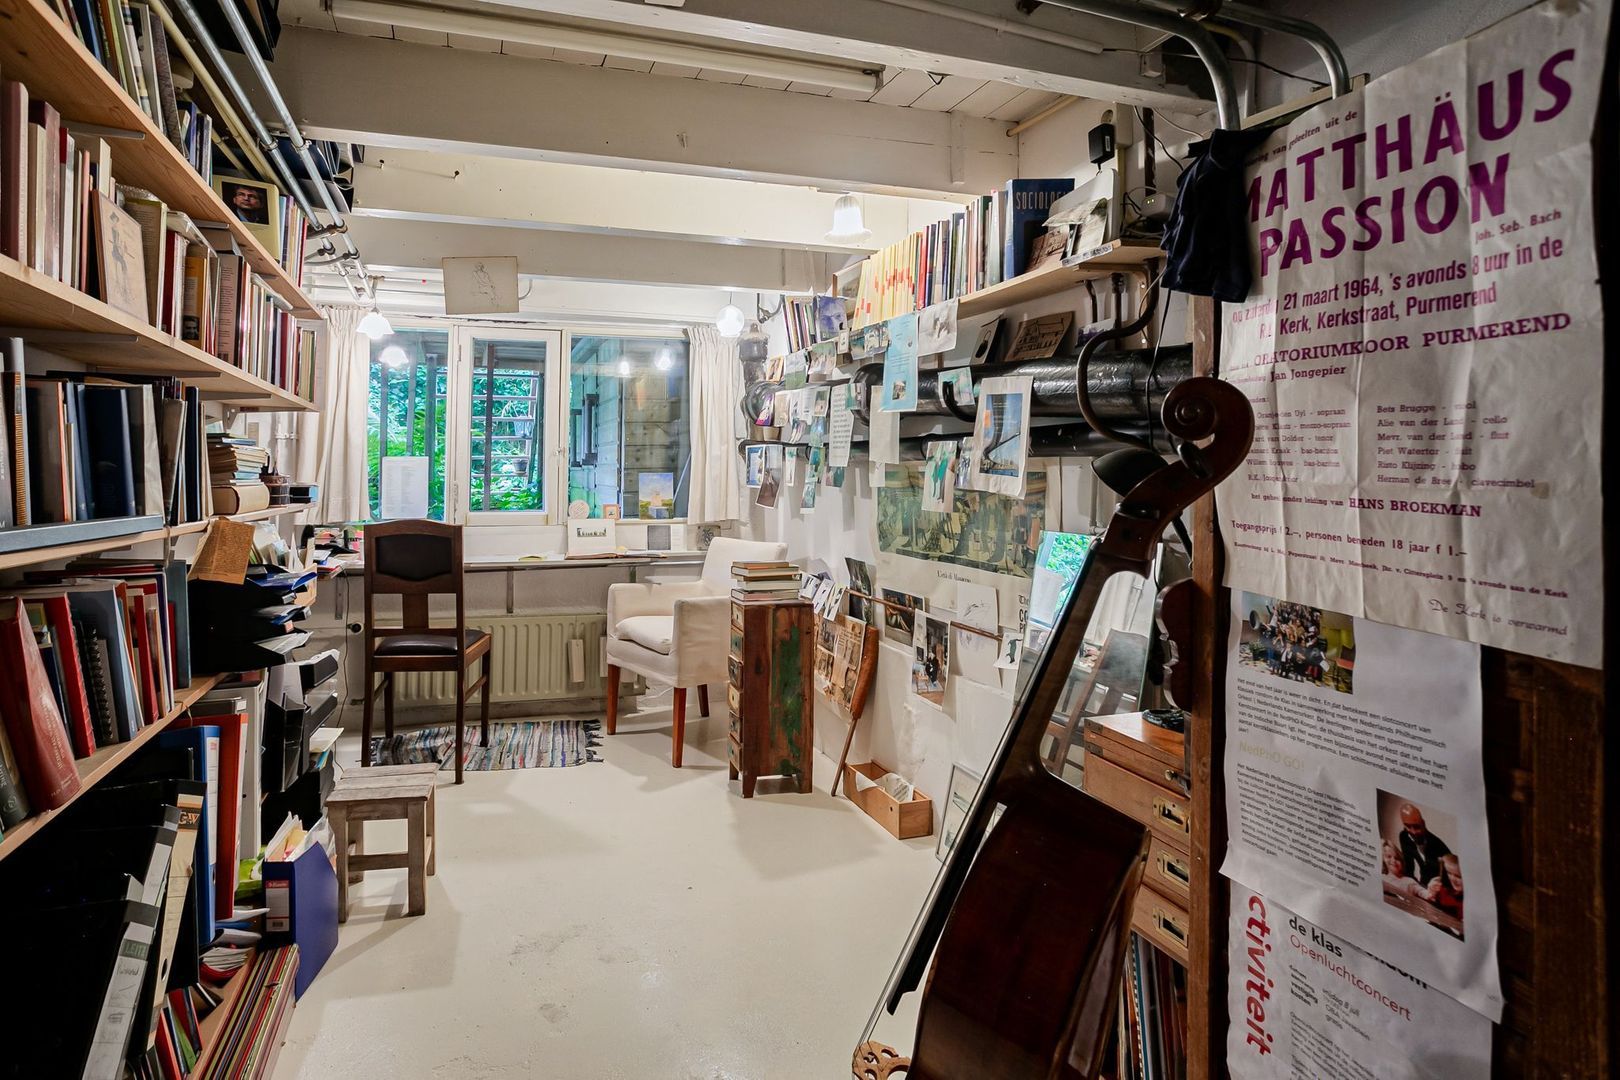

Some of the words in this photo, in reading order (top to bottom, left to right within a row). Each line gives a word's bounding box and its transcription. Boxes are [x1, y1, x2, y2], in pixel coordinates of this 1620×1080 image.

[1272, 144, 1287, 156] van
[1324, 117, 1340, 129] uit
[1344, 110, 1358, 122] de
[1015, 191, 1061, 210] SOCIOLO
[1259, 152, 1510, 278] PASSION
[1475, 231, 1495, 245] Joh.
[1499, 219, 1525, 235] Seb.
[1529, 209, 1562, 227] Bach
[1283, 292, 1297, 310] 21
[1302, 282, 1339, 308] maart
[1343, 275, 1384, 300] 1964,
[1389, 272, 1402, 291] 's
[1406, 260, 1467, 289] avonds
[1472, 255, 1480, 276] 8
[1484, 251, 1511, 273] uur
[1515, 243, 1533, 265] in
[1539, 236, 1564, 261] de
[1279, 315, 1312, 335] Kerk,
[1317, 303, 1400, 330] Kerkstraat,
[1406, 281, 1497, 316] Purmerend
[1254, 335, 1410, 367] ORATORIUMKOOR
[1422, 312, 1571, 348] PURMEREND
[1270, 370, 1287, 383] Jan
[1290, 364, 1348, 380] Jongepier
[1400, 403, 1436, 414] Brugge
[1400, 419, 1416, 427] van
[1420, 417, 1438, 426] der
[1482, 415, 1508, 424] cello
[1377, 433, 1403, 441] Mevr.
[1428, 432, 1447, 441] der
[1377, 475, 1410, 484] Herman
[1349, 497, 1385, 511] HANS
[1390, 500, 1482, 518] BROEKMAN
[1231, 519, 1277, 535] Toegangsprijs
[1305, 531, 1342, 542] personen
[1346, 534, 1385, 548] beneden
[1391, 539, 1403, 550] 18
[1408, 541, 1430, 554] jaar
[1435, 544, 1442, 555] f
[1528, 585, 1541, 595] de
[1544, 588, 1569, 600] Kerk
[1428, 598, 1448, 614] De
[1455, 601, 1487, 621] Kerk
[1289, 916, 1307, 936] de
[1311, 927, 1343, 958] klas
[1290, 934, 1412, 1021] Openluchtconcert
